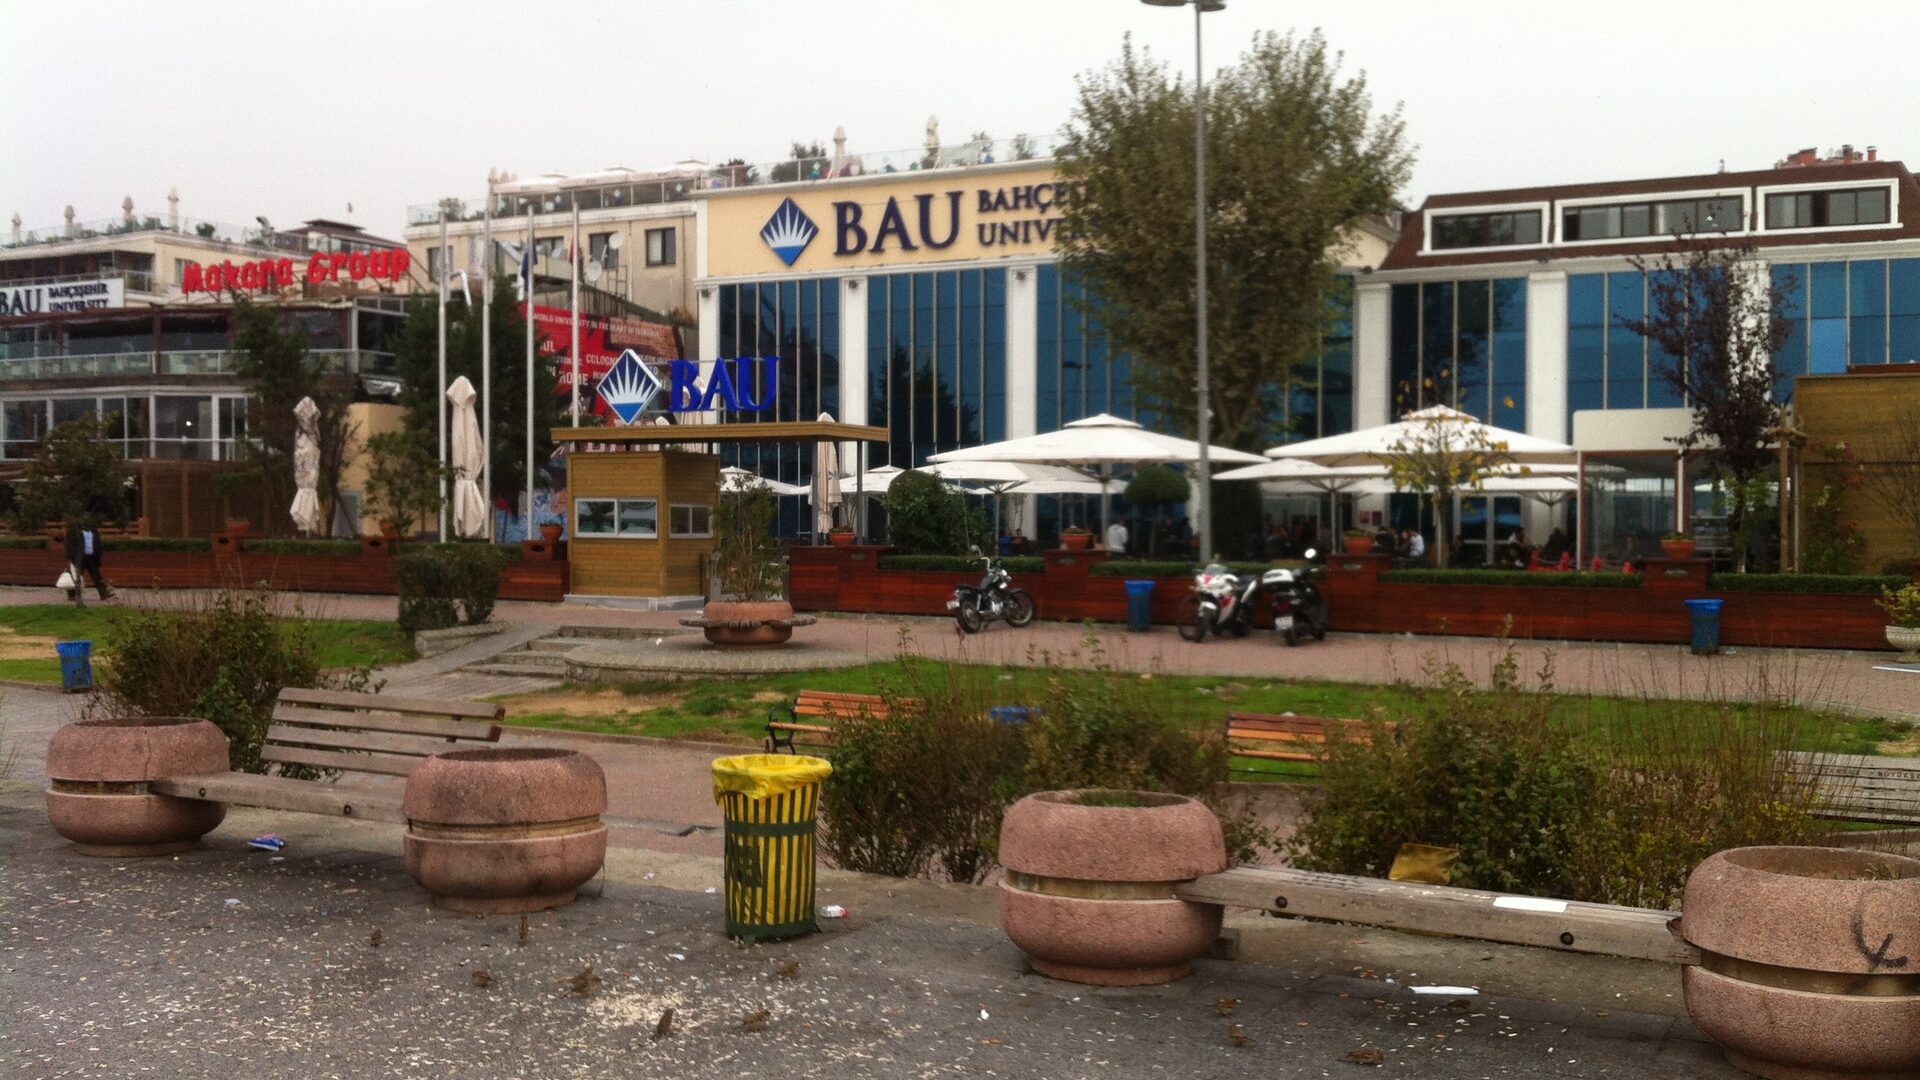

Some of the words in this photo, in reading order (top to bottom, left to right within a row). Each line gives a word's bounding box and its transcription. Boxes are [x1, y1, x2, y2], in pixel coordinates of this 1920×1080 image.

[977, 183, 1070, 215] BAHÇE
[832, 190, 964, 257] BAU
[182, 258, 294, 294] Makara
[307, 248, 411, 284] Group
[48, 298, 109, 313] UNIVERSITY
[668, 355, 780, 413] BAU
